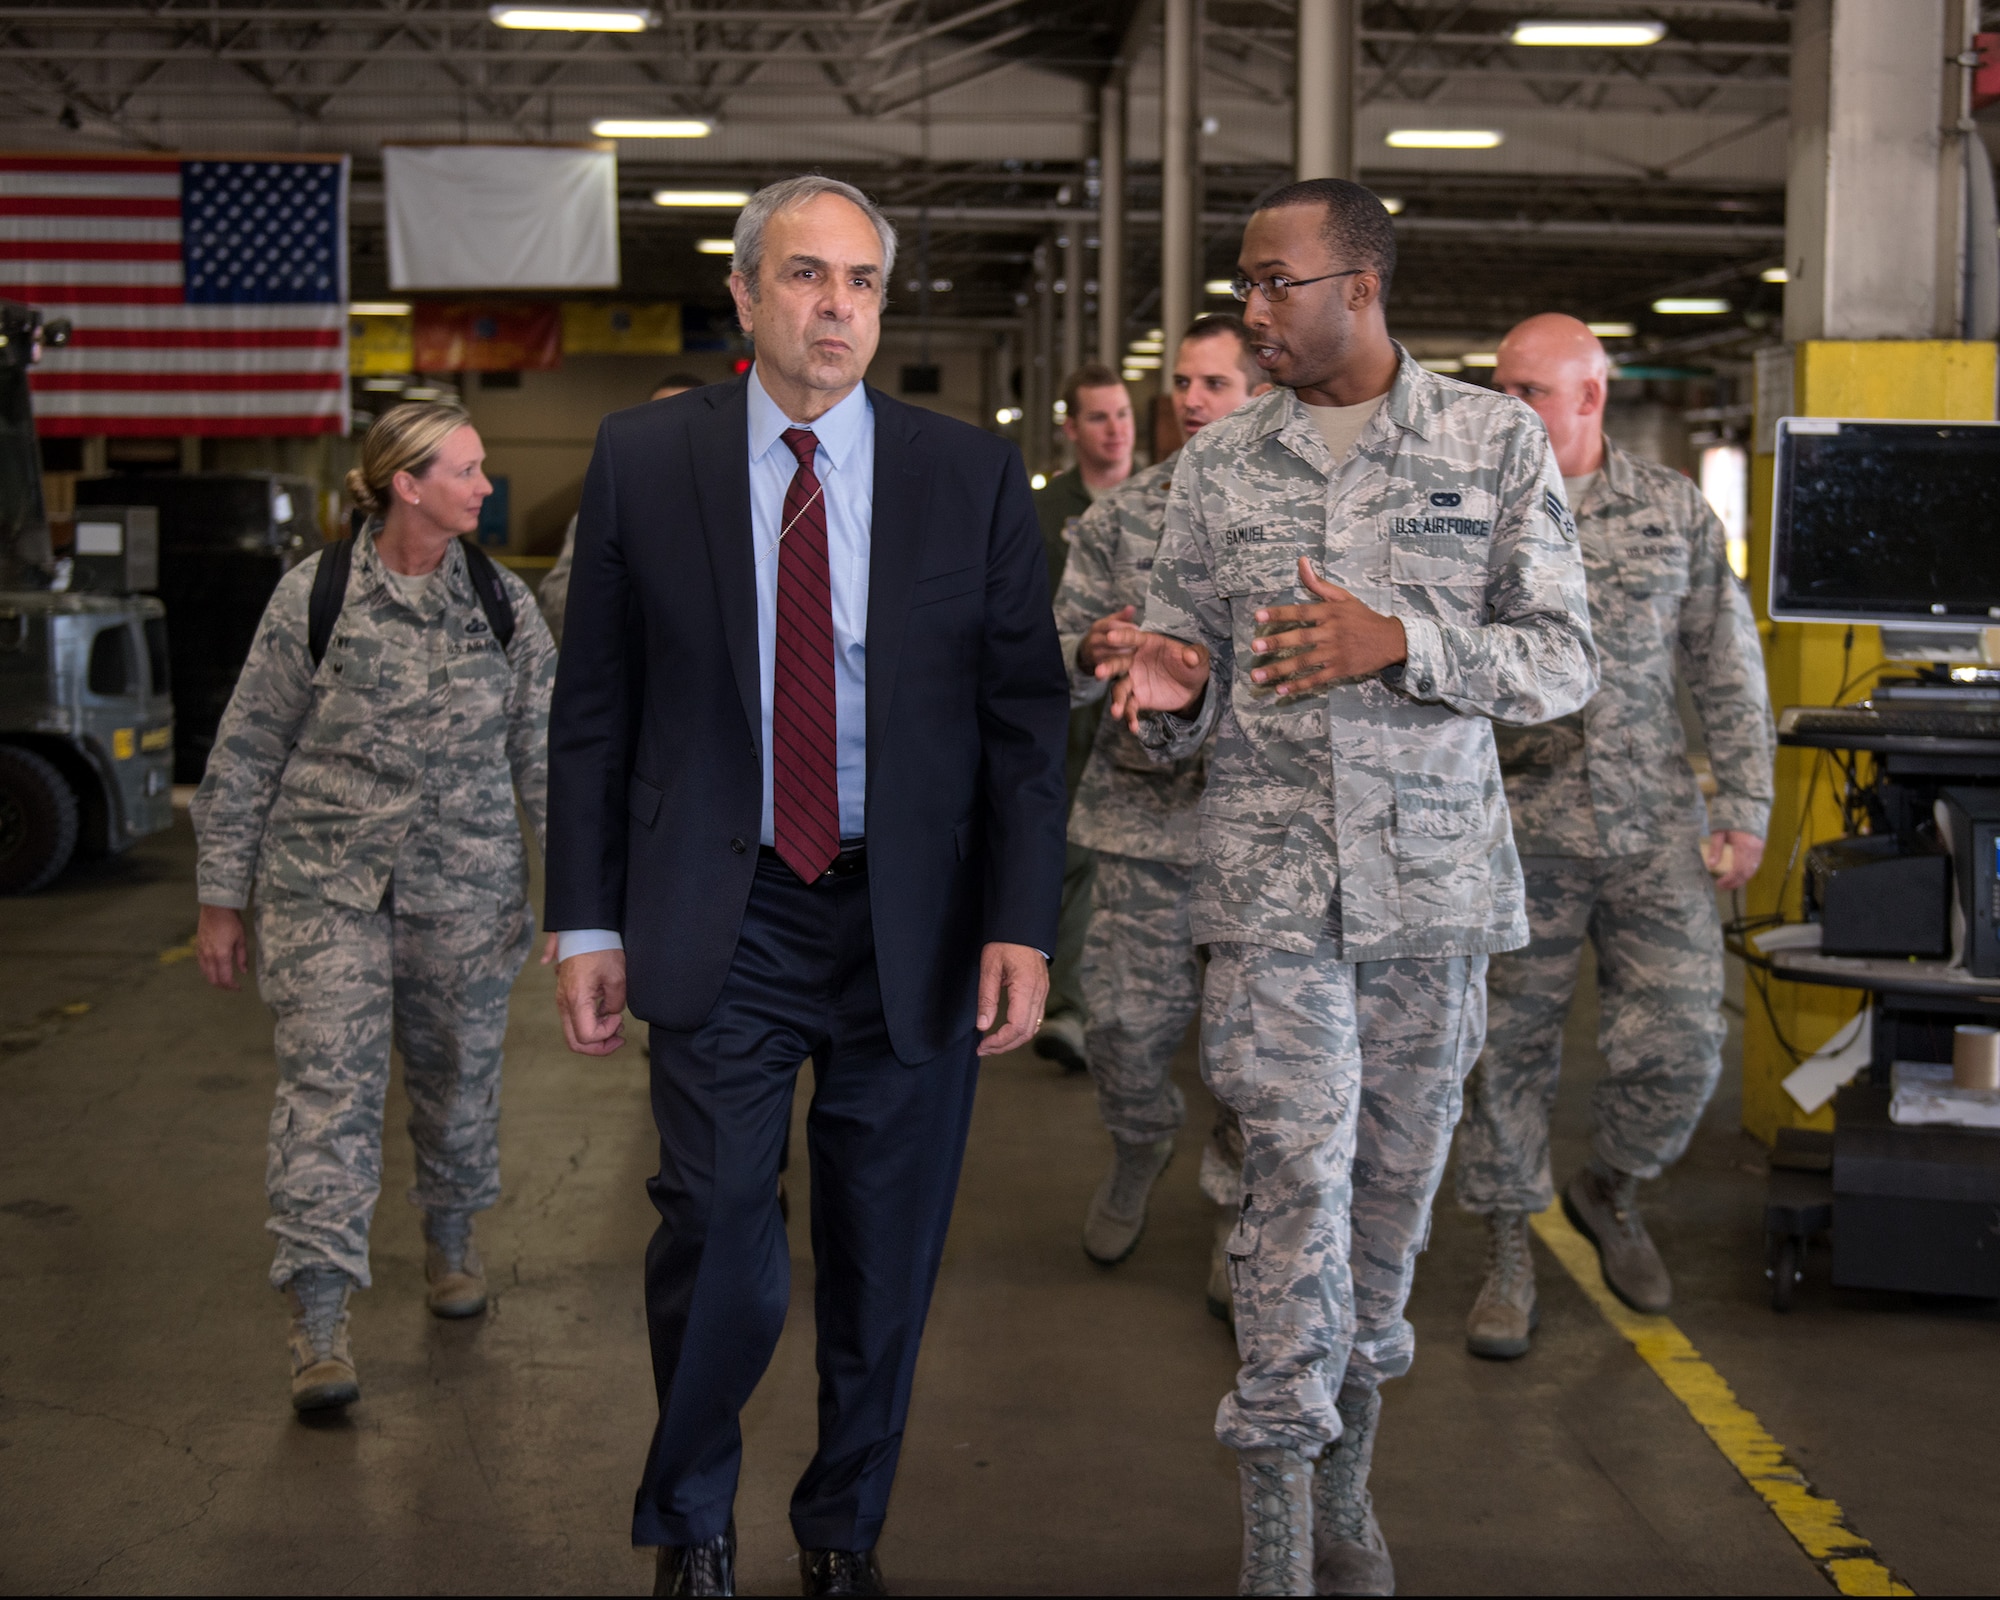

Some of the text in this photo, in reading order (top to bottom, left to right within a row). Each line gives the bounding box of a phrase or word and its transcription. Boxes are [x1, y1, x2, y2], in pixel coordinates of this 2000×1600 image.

[1225, 525, 1267, 546] SAMUEL
[1395, 517, 1489, 536] U.S. AIR FORCE
